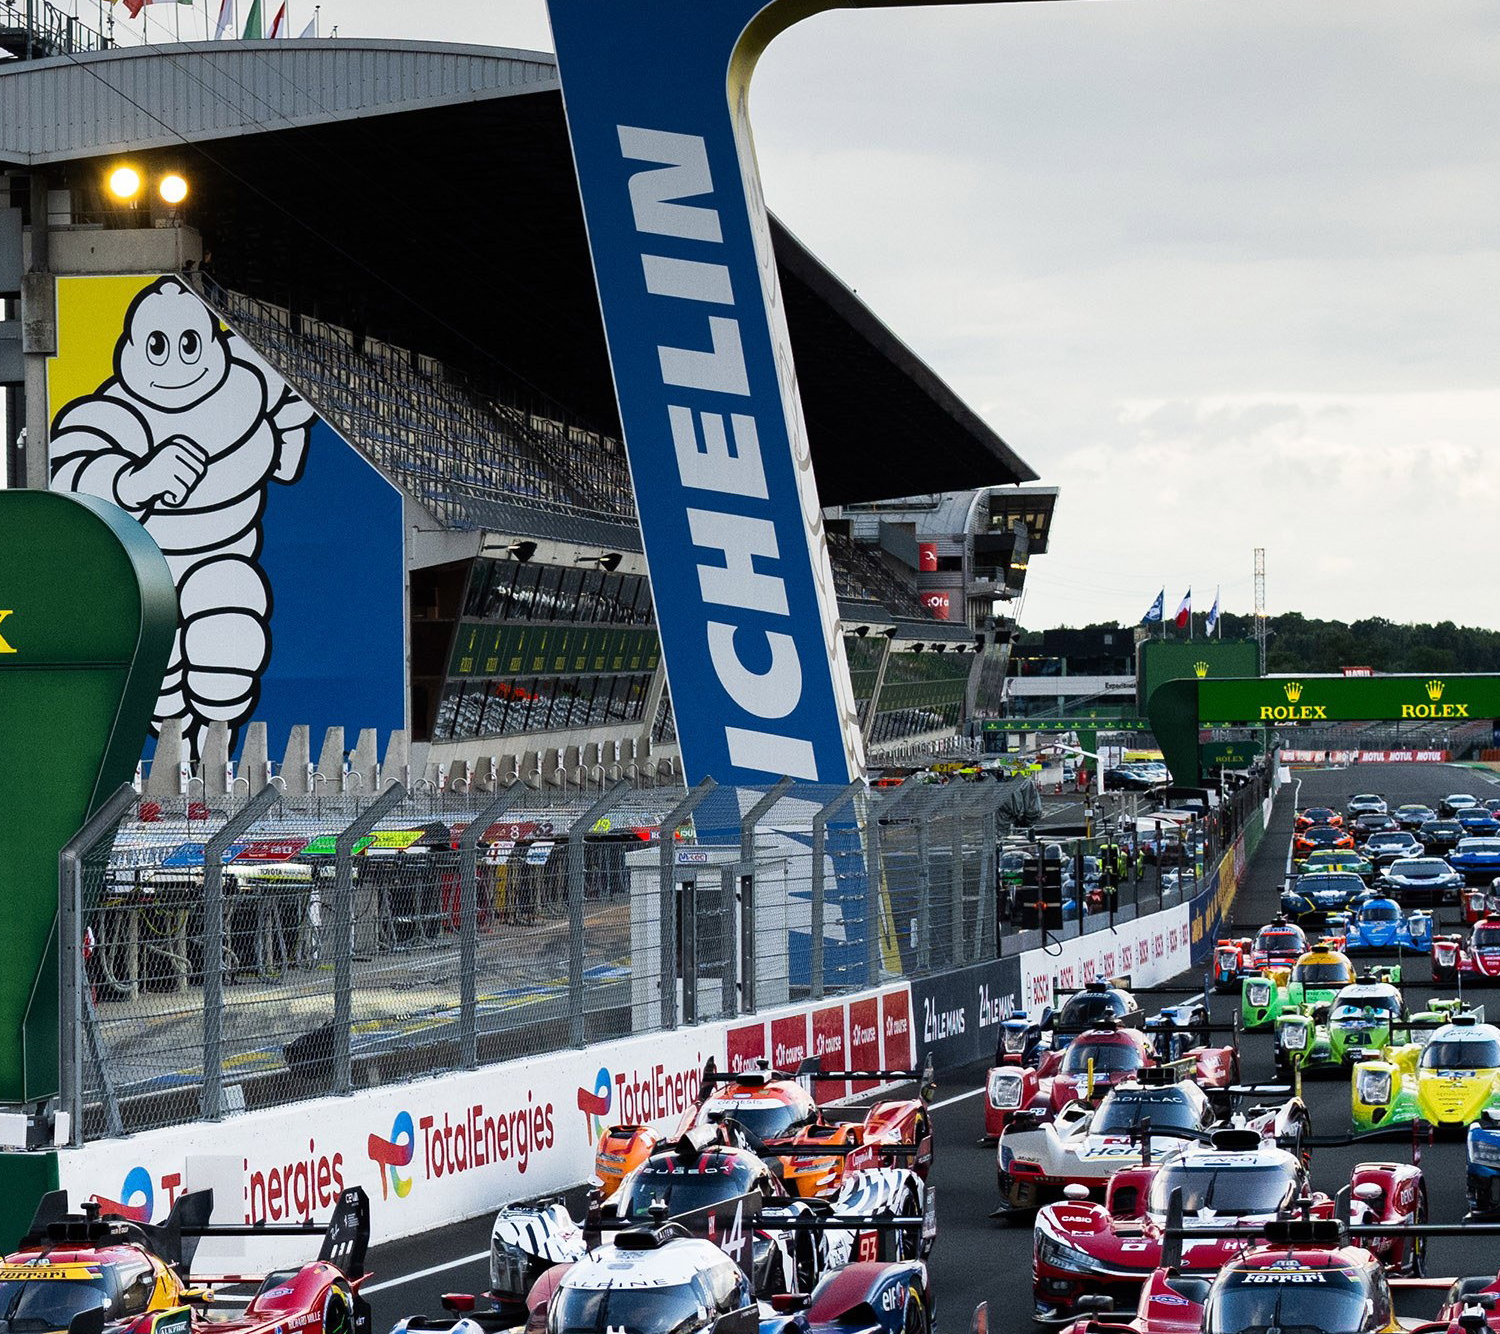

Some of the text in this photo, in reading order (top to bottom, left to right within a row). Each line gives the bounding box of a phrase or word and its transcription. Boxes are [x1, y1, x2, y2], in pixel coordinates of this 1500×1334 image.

[616, 125, 848, 942] MICHELIN
[1260, 705, 1327, 720] ROLEX
[1401, 704, 1469, 718] ROLEX
[420, 1091, 553, 1174] TotalEnergies
[1061, 1215, 1092, 1223] CASIO
[860, 1237, 877, 1259] 93
[1241, 1271, 1328, 1285] Ferrari
[882, 1287, 897, 1312] elf
[288, 1310, 321, 1330] RICHARD MILLE
